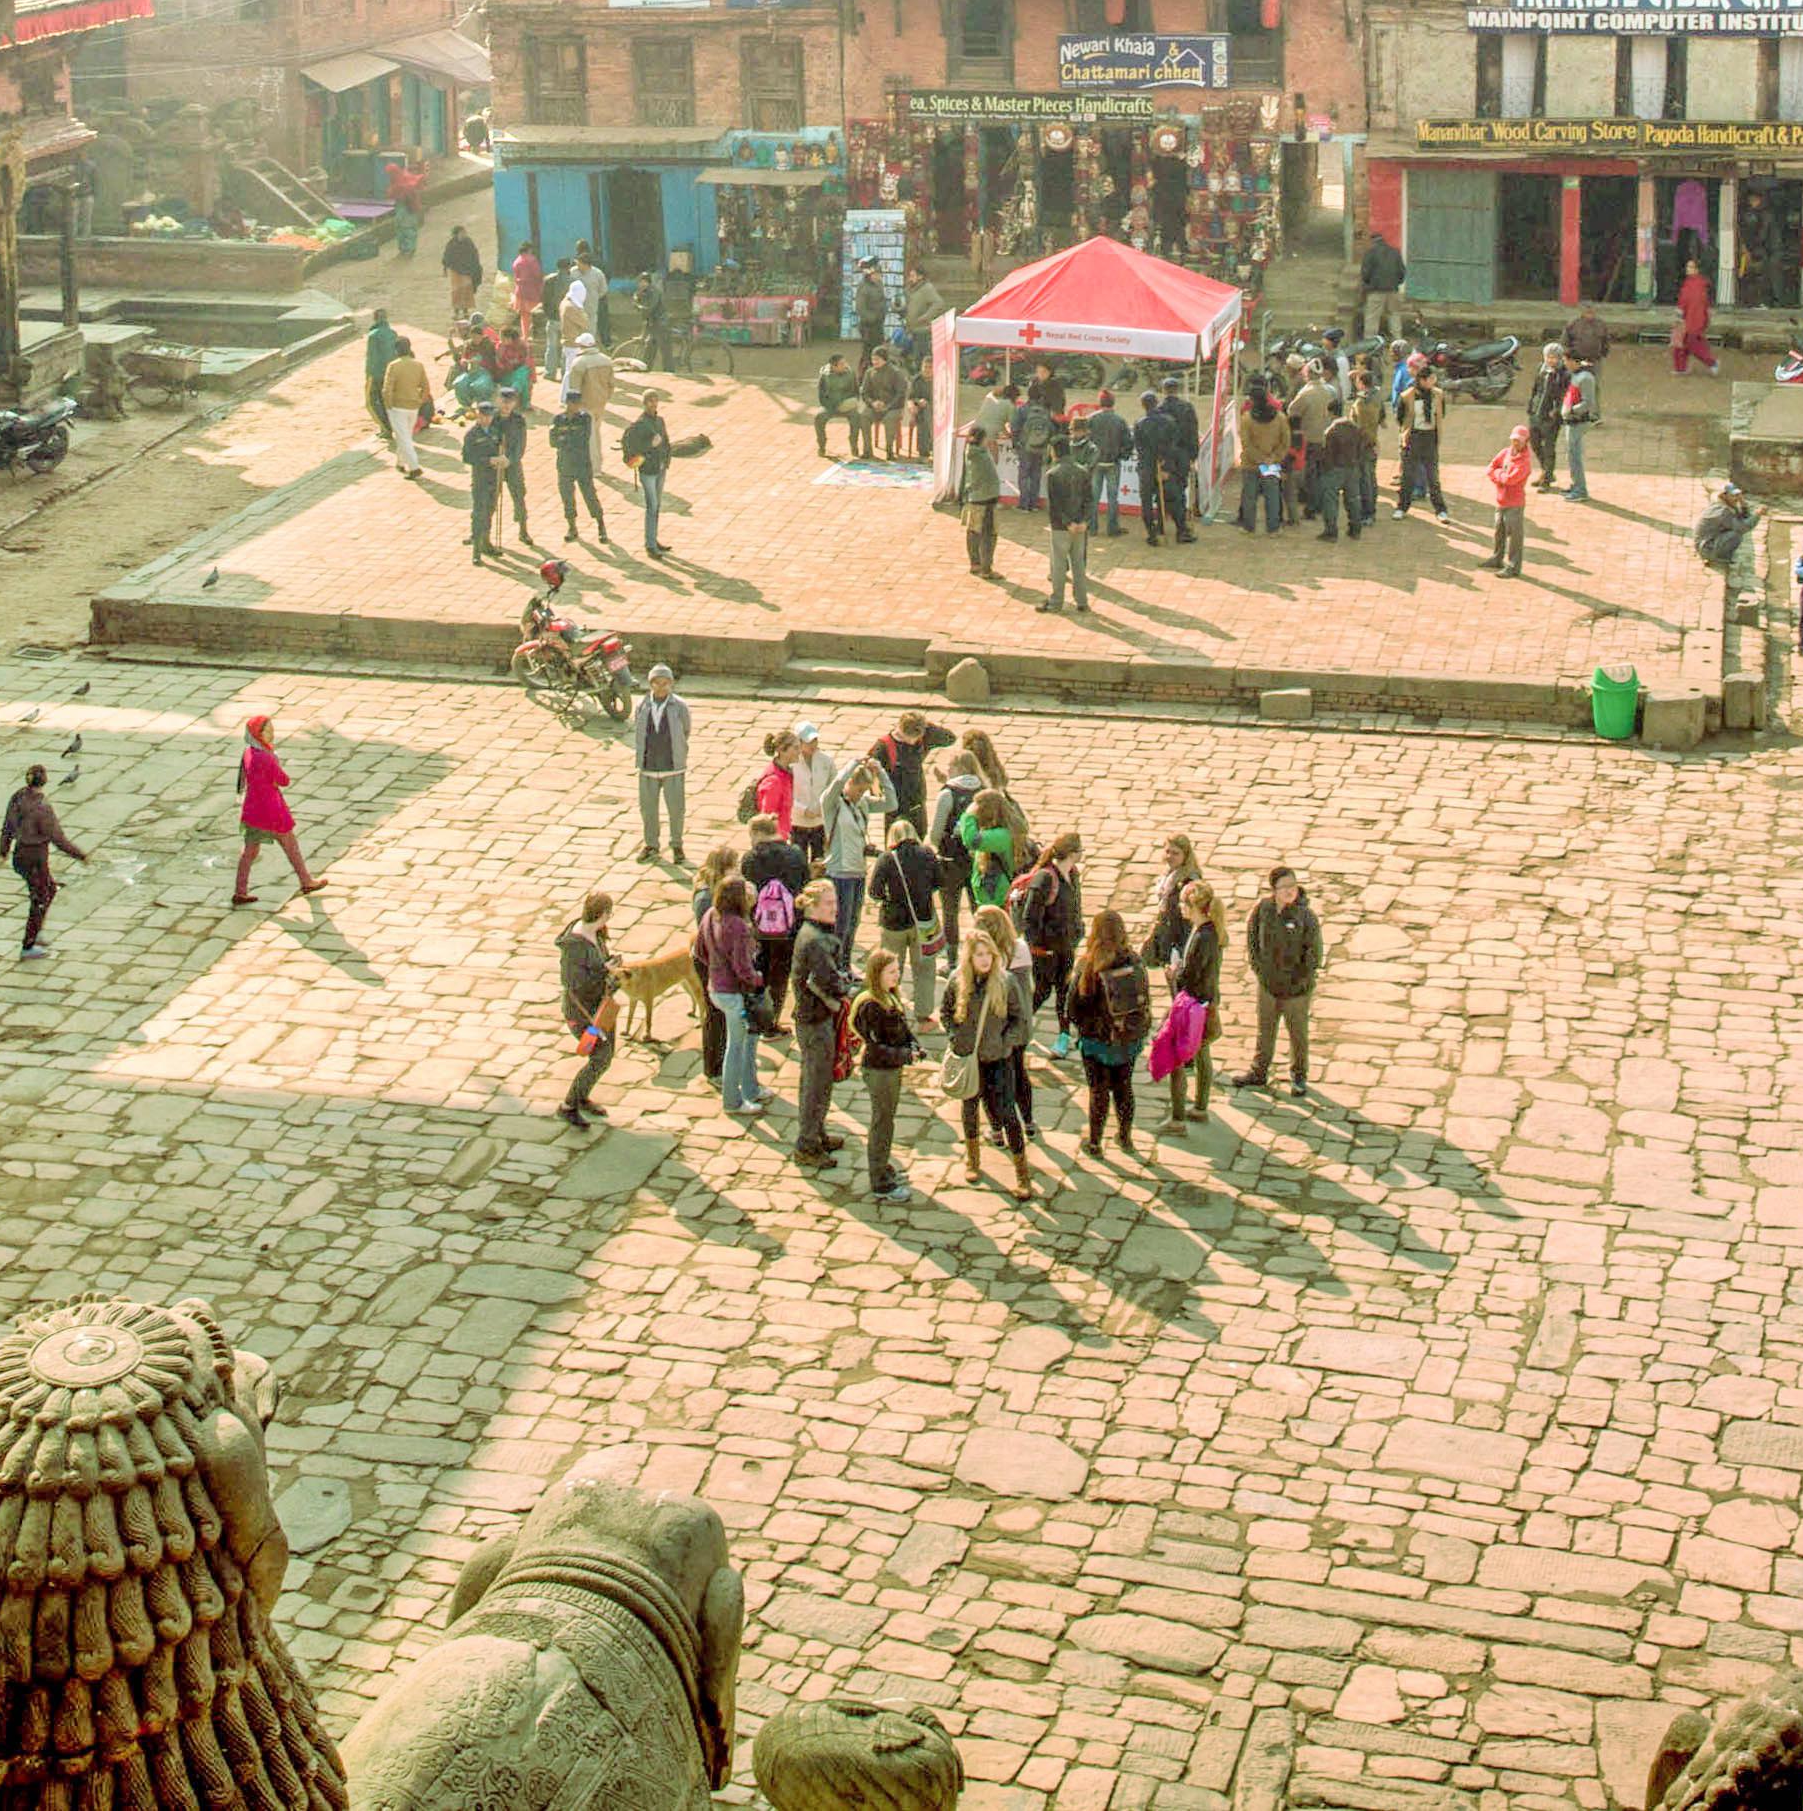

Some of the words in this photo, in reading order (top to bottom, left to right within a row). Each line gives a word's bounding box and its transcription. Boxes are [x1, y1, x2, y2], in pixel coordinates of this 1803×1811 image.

[1467, 11, 1590, 30] MAINPOINT
[1593, 12, 1715, 31] COMPUTER
[1060, 37, 1110, 65] Newari
[1113, 37, 1155, 57] Khaja
[1168, 41, 1179, 57] &
[1061, 63, 1150, 80] Chattamari
[1153, 64, 1201, 80] chhen
[909, 96, 928, 111] ea,
[929, 94, 969, 116] Spices
[971, 96, 983, 111] &
[984, 96, 1032, 113] Master
[1033, 97, 1073, 113] Pieces
[1075, 95, 1154, 115] Handicrafts
[1417, 119, 1488, 142] Manandhar
[1491, 120, 1530, 141] Wood
[1534, 121, 1587, 143] Carving
[1591, 120, 1638, 141] Store
[1645, 124, 1695, 147] Pagoda
[1698, 125, 1774, 145] Handicraft
[1776, 125, 1789, 144] &
